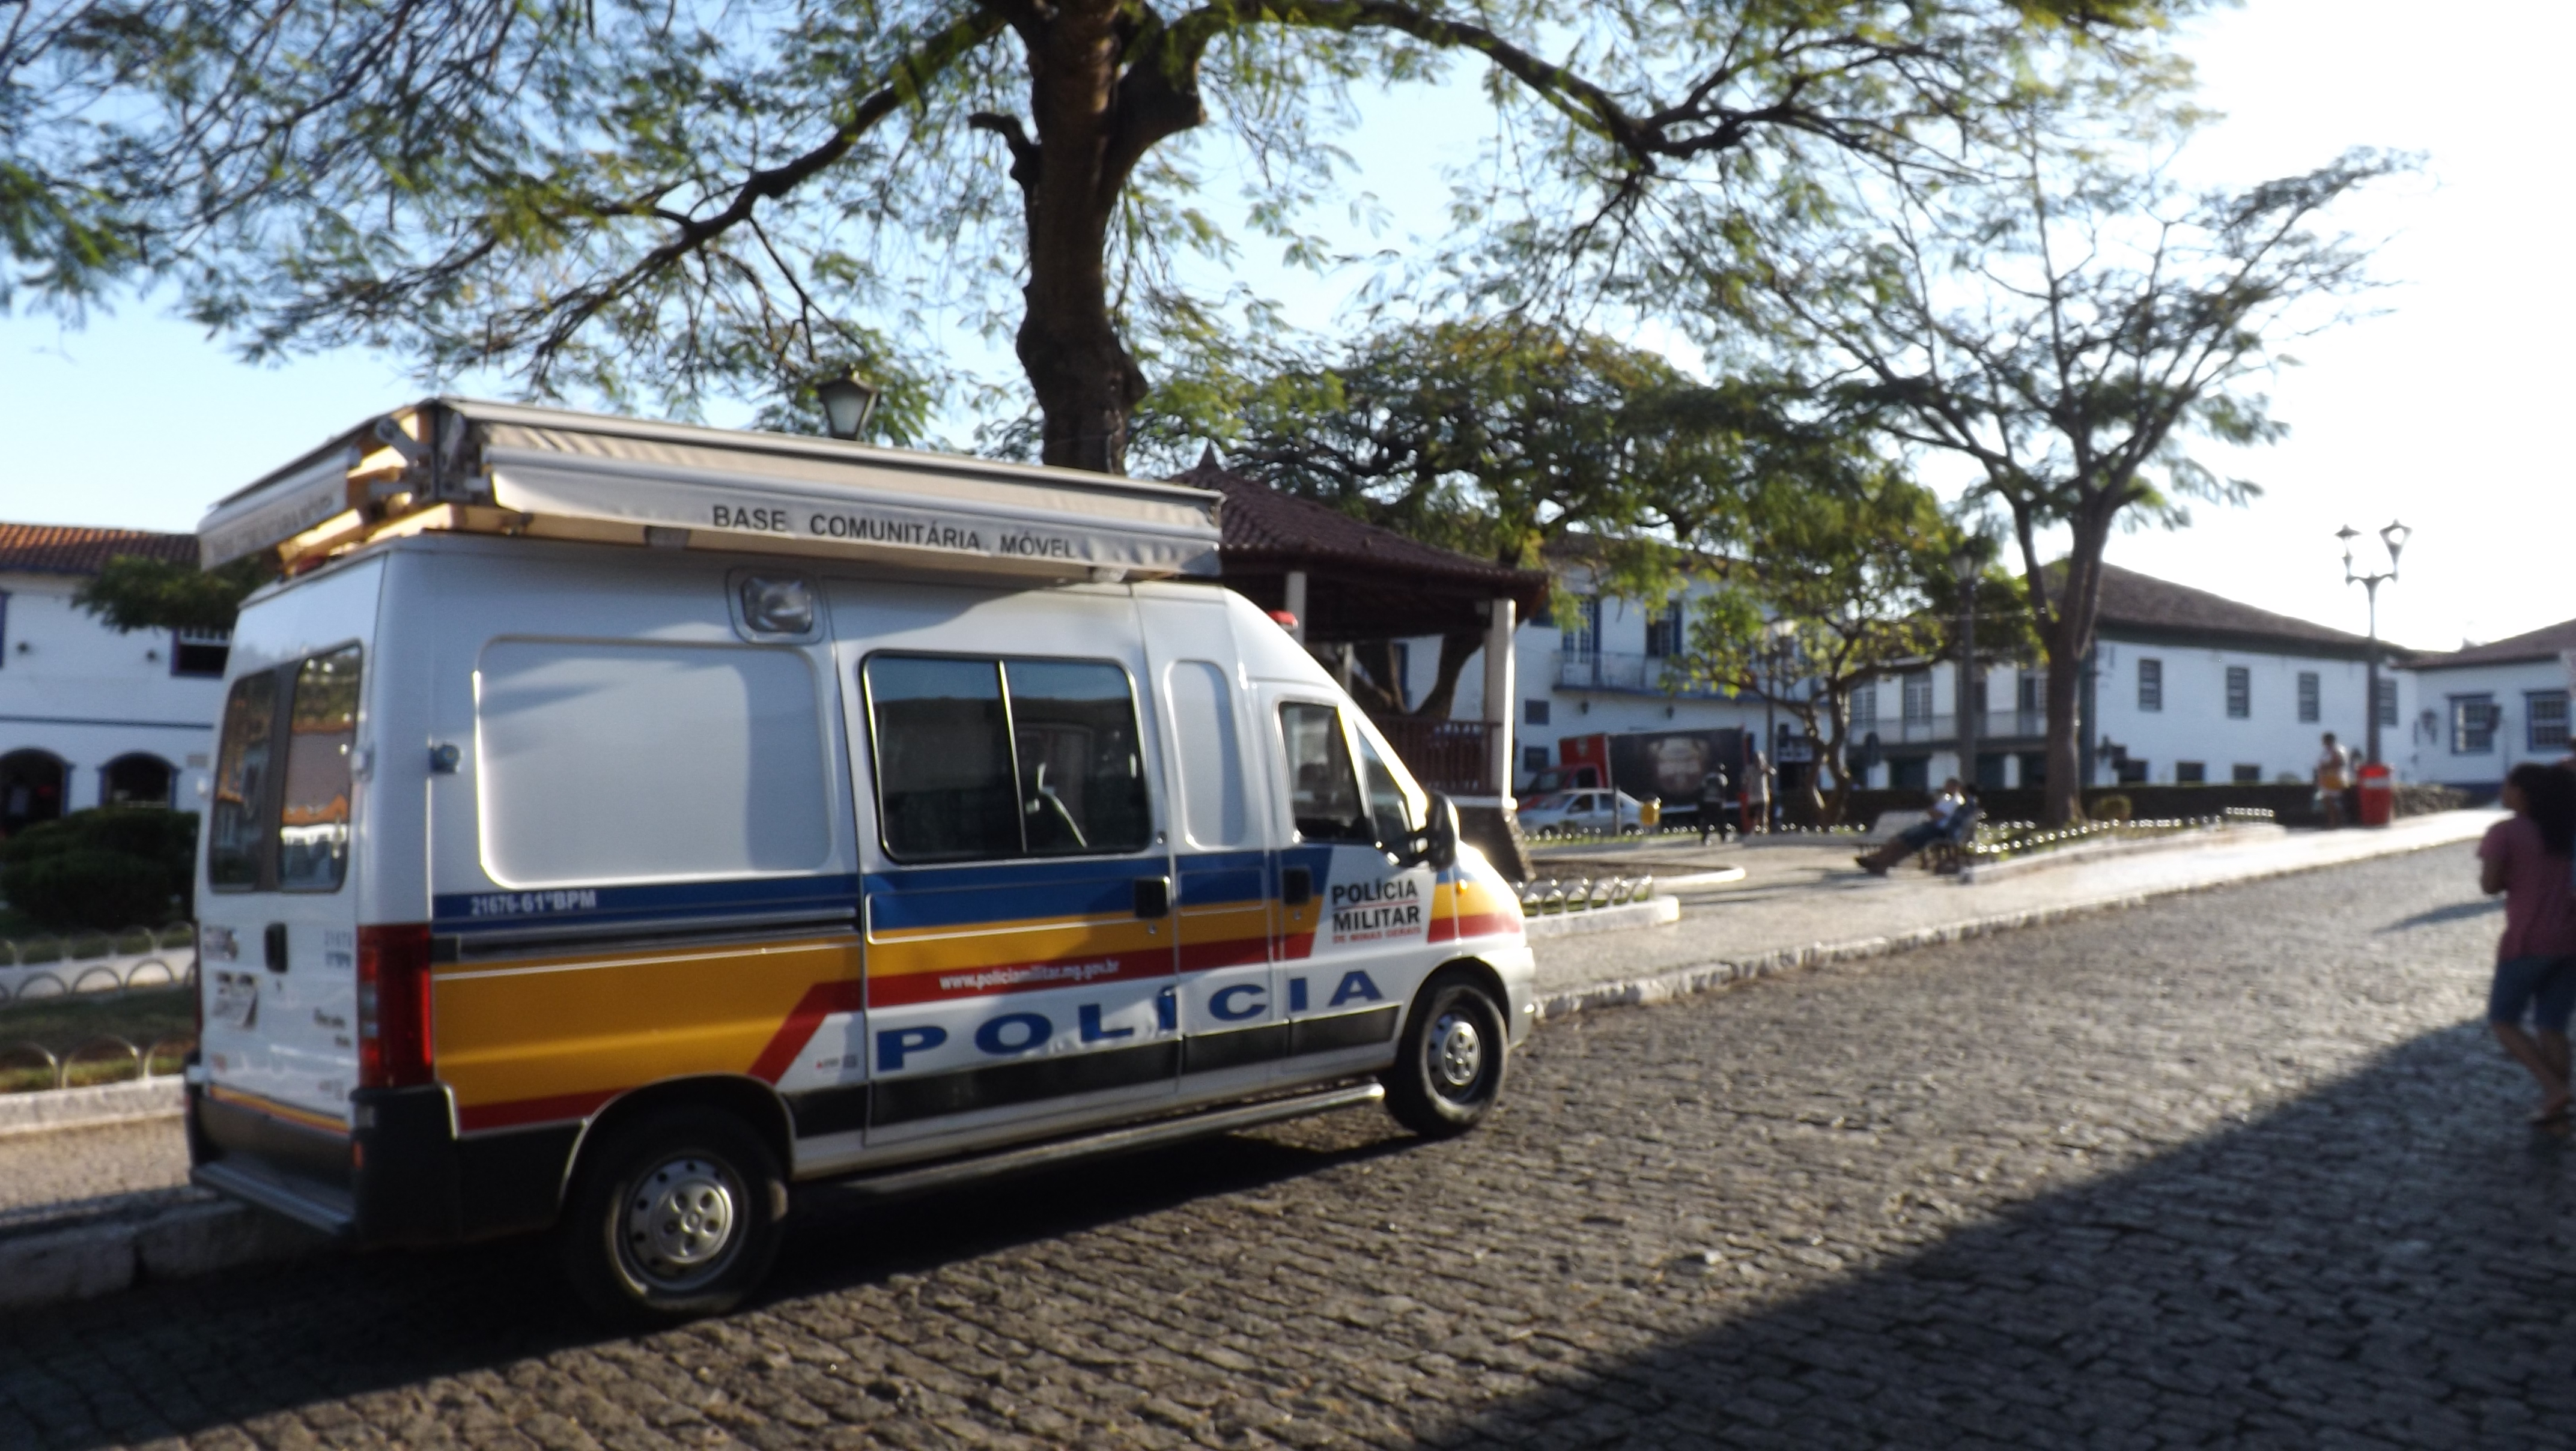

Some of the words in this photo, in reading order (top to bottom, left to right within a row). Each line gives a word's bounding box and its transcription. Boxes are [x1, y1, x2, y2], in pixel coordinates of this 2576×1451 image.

[713, 504, 786, 533] BASE
[810, 513, 980, 552] COMUNITÁRIA
[1000, 532, 1077, 559] MÓVEL
[1332, 877, 1417, 904] POLÍCIA
[1333, 905, 1420, 932] MILITAR
[876, 969, 1385, 1073] POLÍCIA
